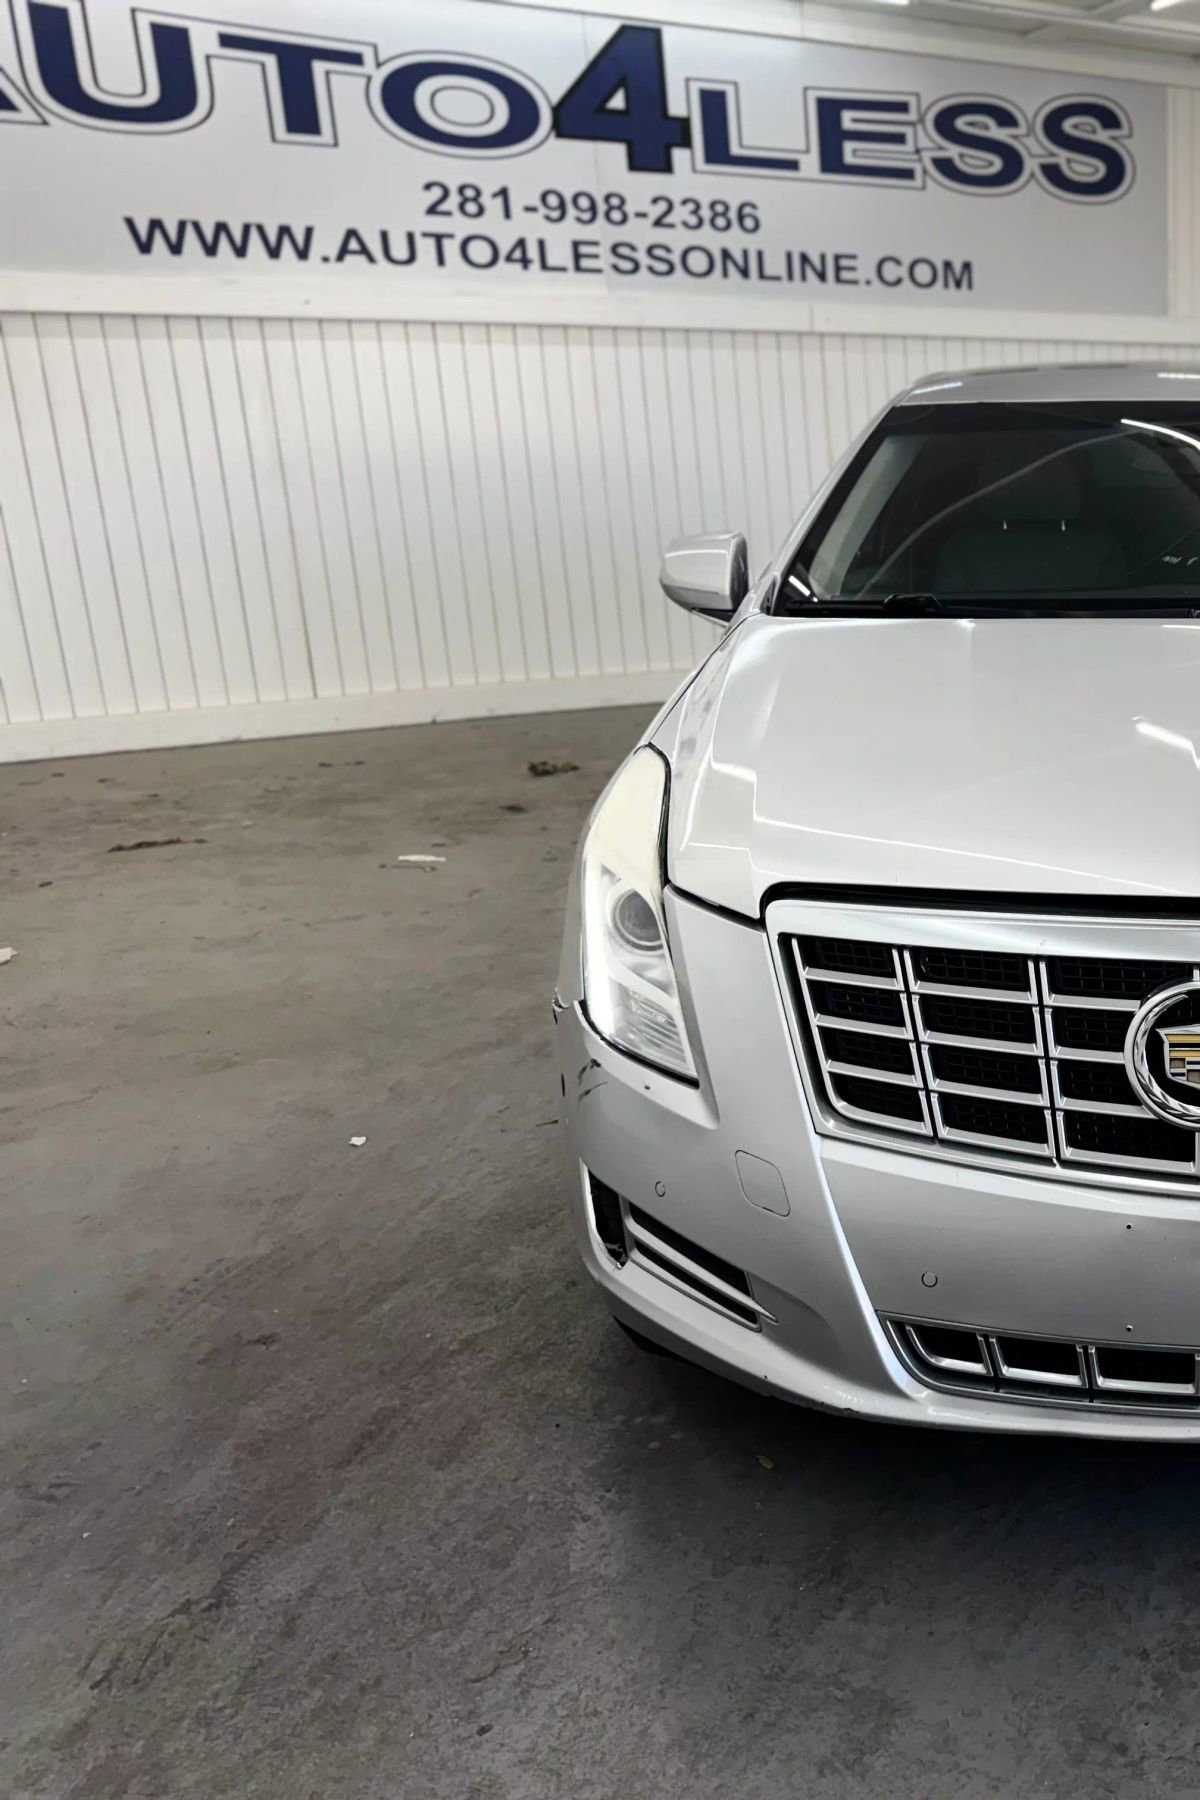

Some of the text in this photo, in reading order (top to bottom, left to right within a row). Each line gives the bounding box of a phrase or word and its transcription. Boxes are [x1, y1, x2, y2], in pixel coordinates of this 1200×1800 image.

[0, 0, 1134, 204] UTO4LESS
[422, 181, 761, 234] 281-998-2386
[122, 216, 974, 291] WWW.AUTO4LESSONLINE.COM
